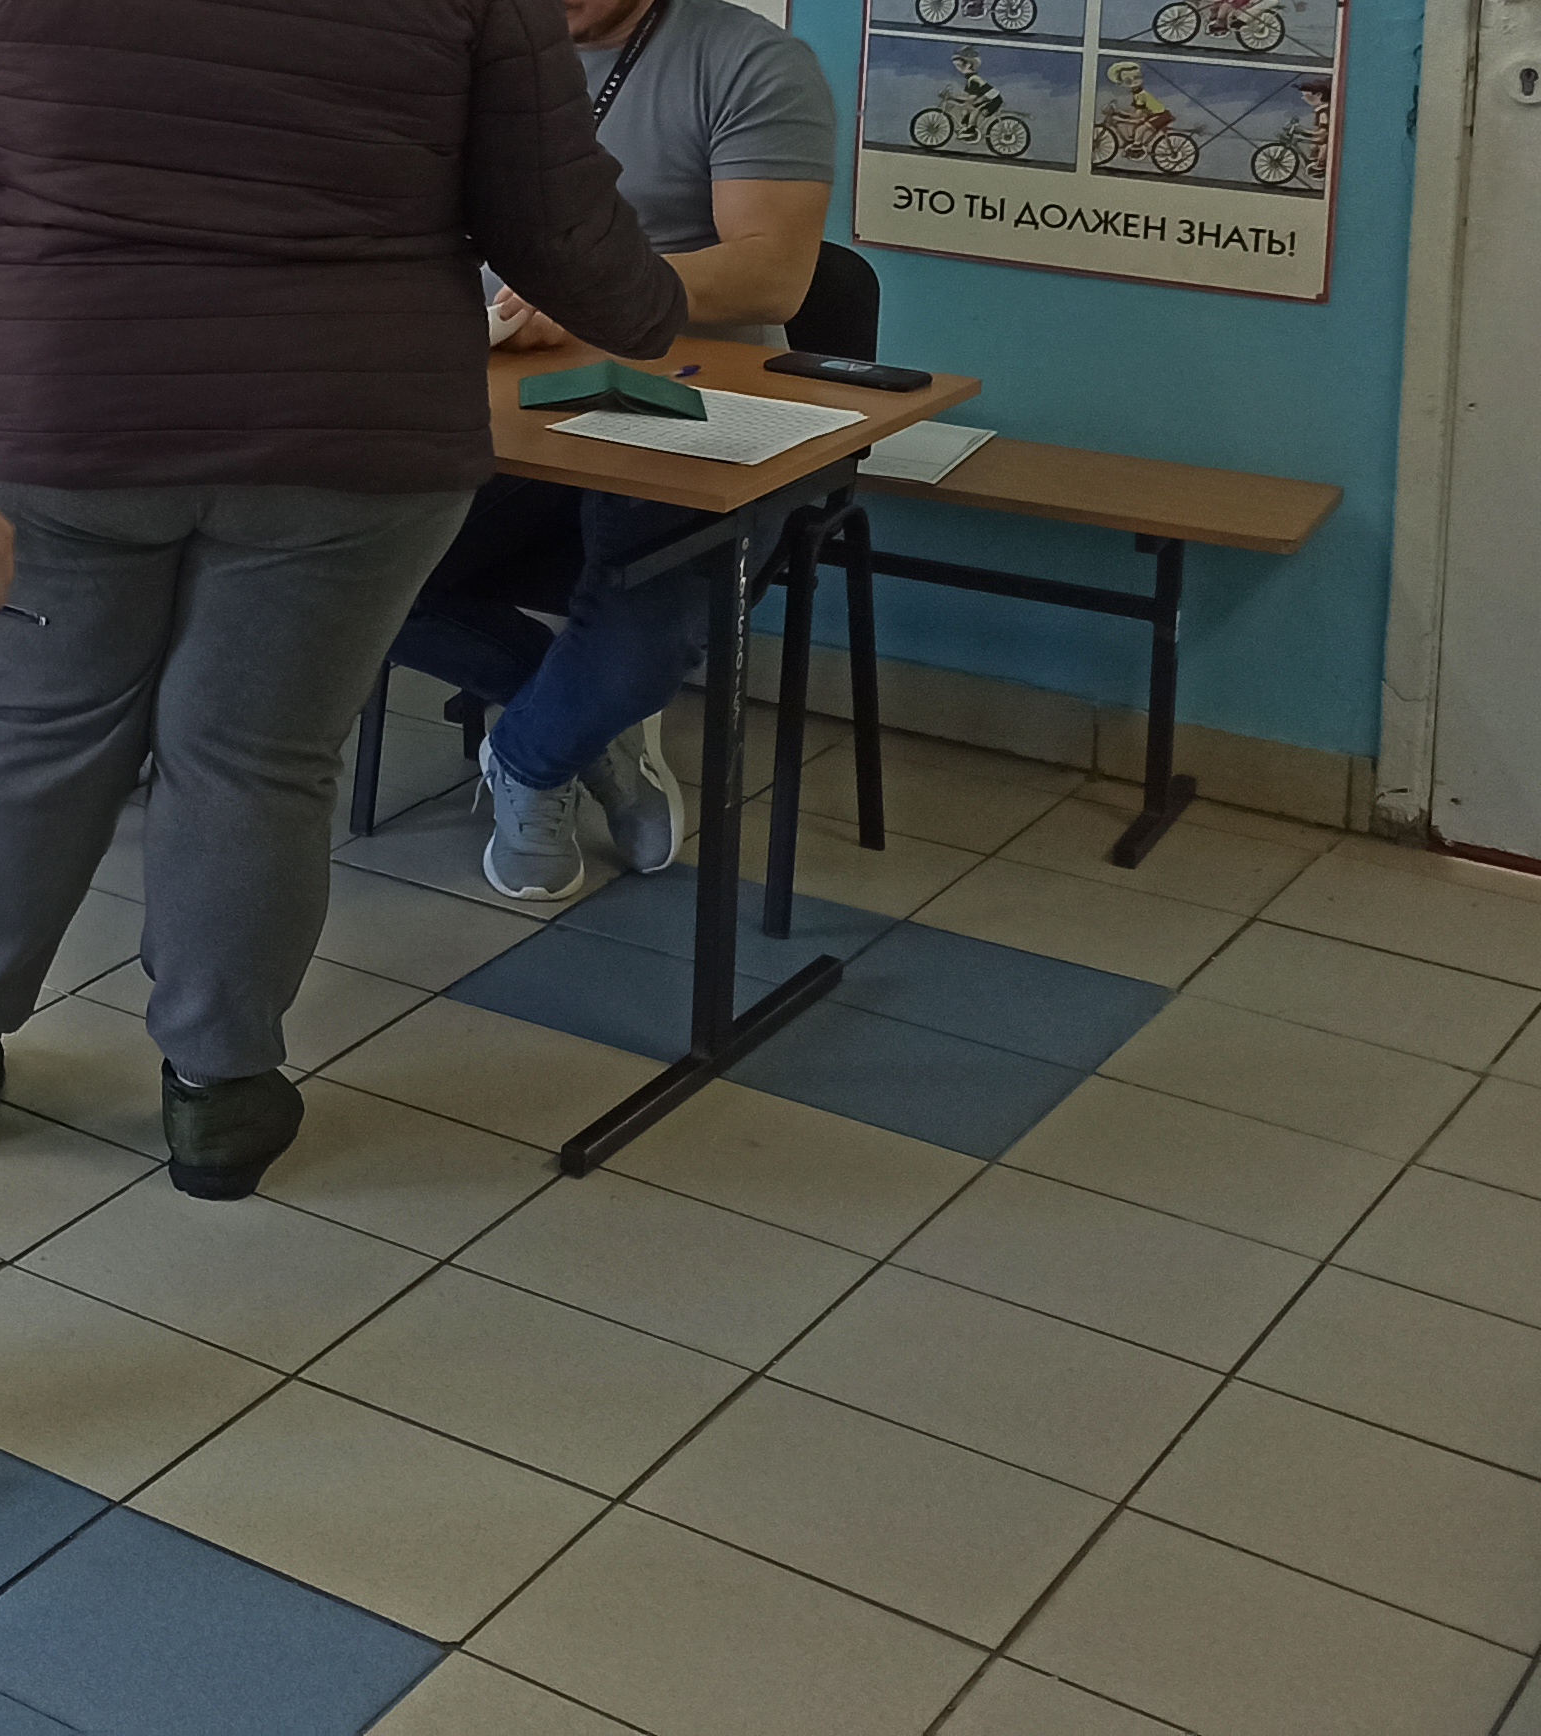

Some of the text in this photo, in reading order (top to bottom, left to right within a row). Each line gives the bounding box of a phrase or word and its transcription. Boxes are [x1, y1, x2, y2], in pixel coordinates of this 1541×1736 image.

[892, 185, 1297, 258] ЭТО ТЫ ДОЛЖЕН ЗНАТЬ!
